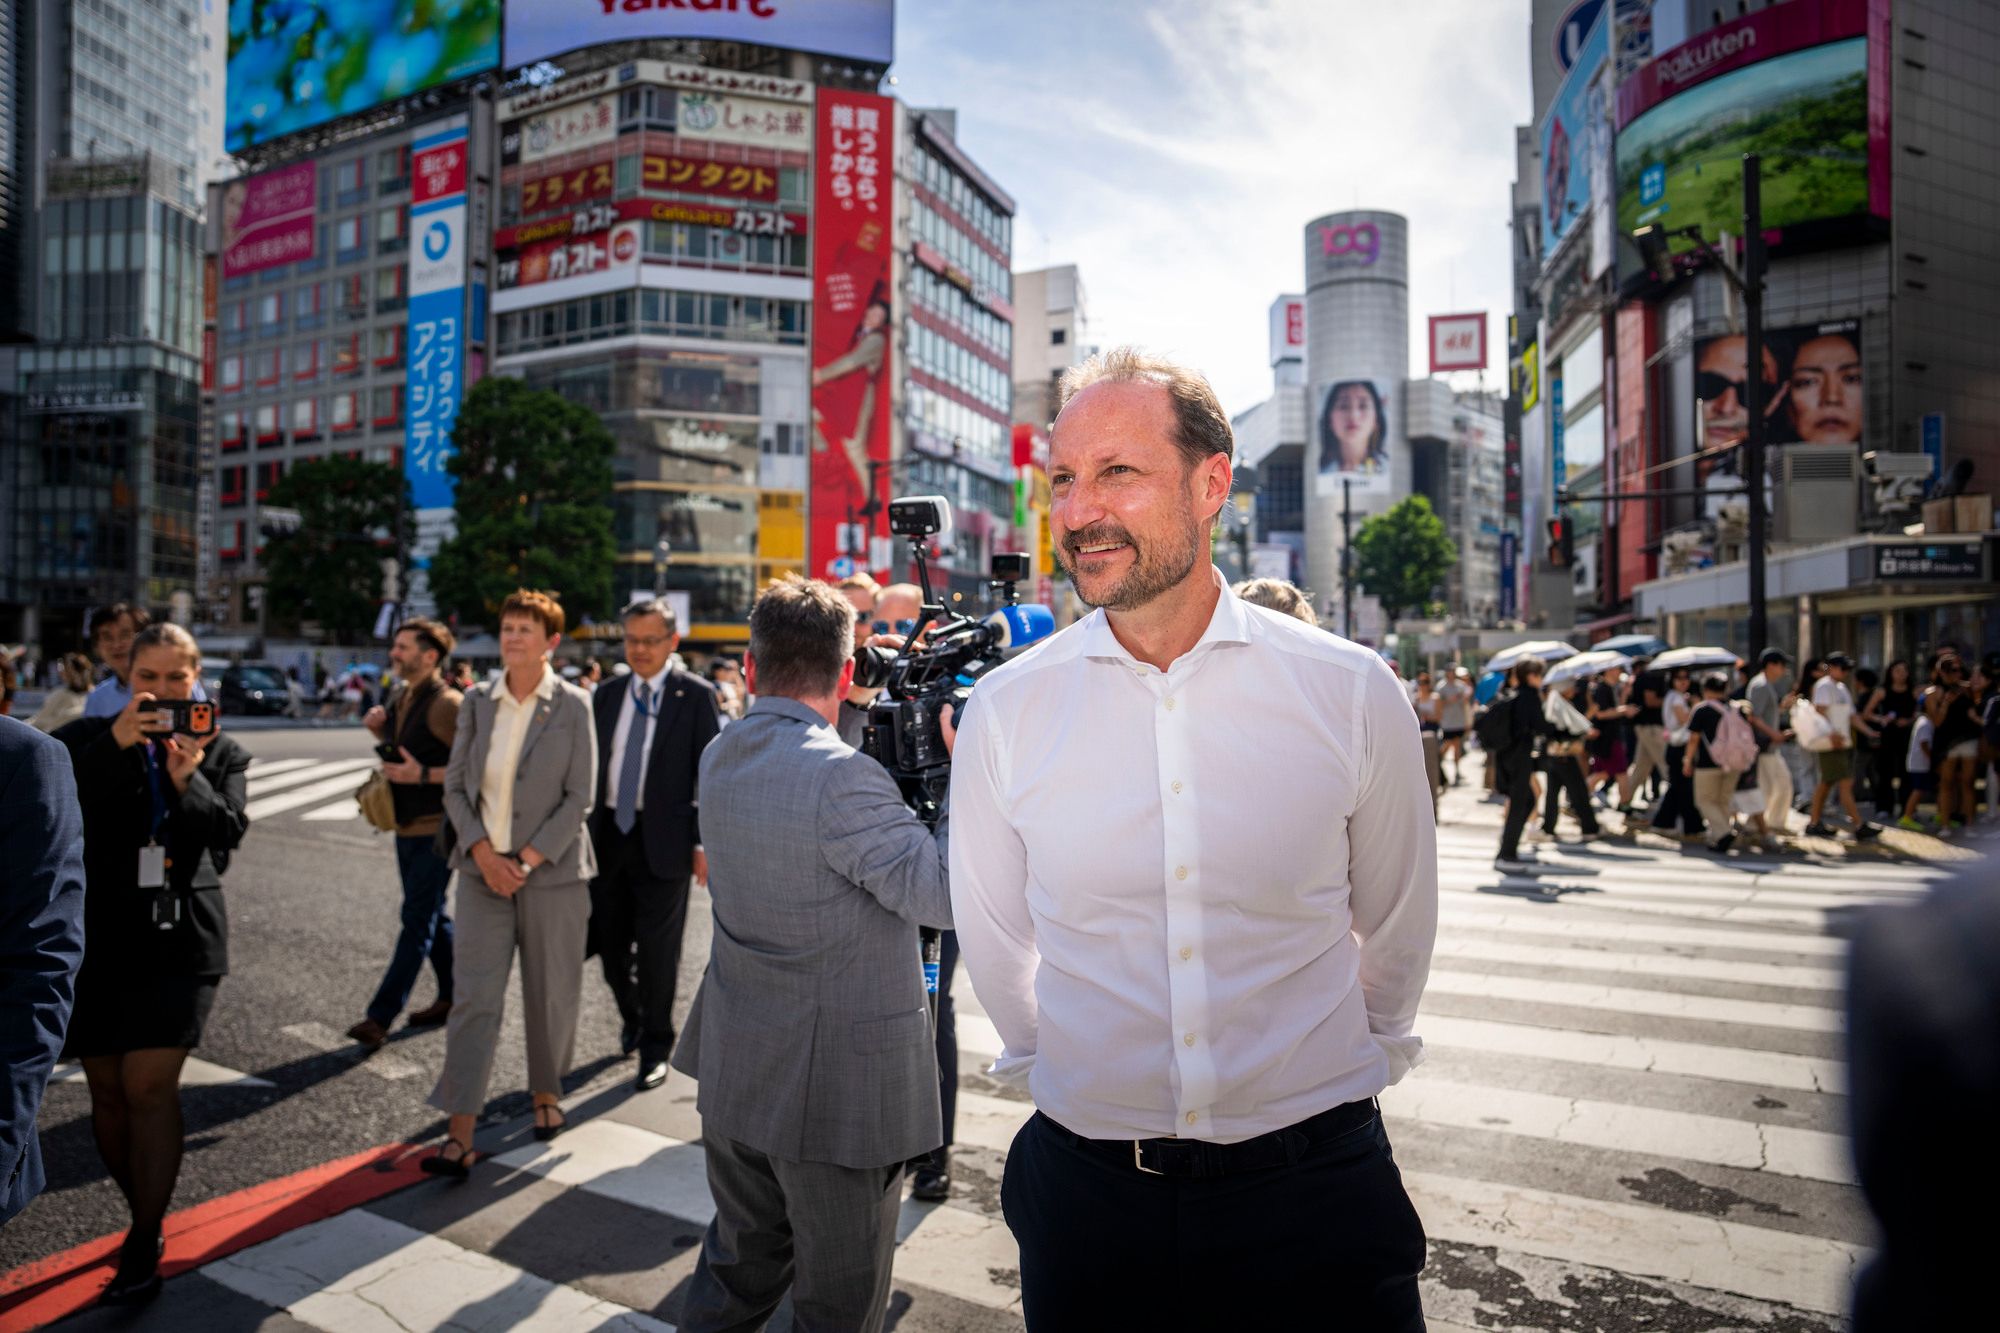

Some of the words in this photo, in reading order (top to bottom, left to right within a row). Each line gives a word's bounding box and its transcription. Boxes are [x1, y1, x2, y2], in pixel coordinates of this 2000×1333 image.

[1657, 26, 1757, 86] Rakuten
[643, 156, 774, 194] コンタクト
[572, 205, 620, 235] ガスト
[734, 209, 796, 235] ガスト
[547, 241, 606, 280] ガスト
[1316, 221, 1381, 268] 109
[411, 320, 437, 473] アイシティ
